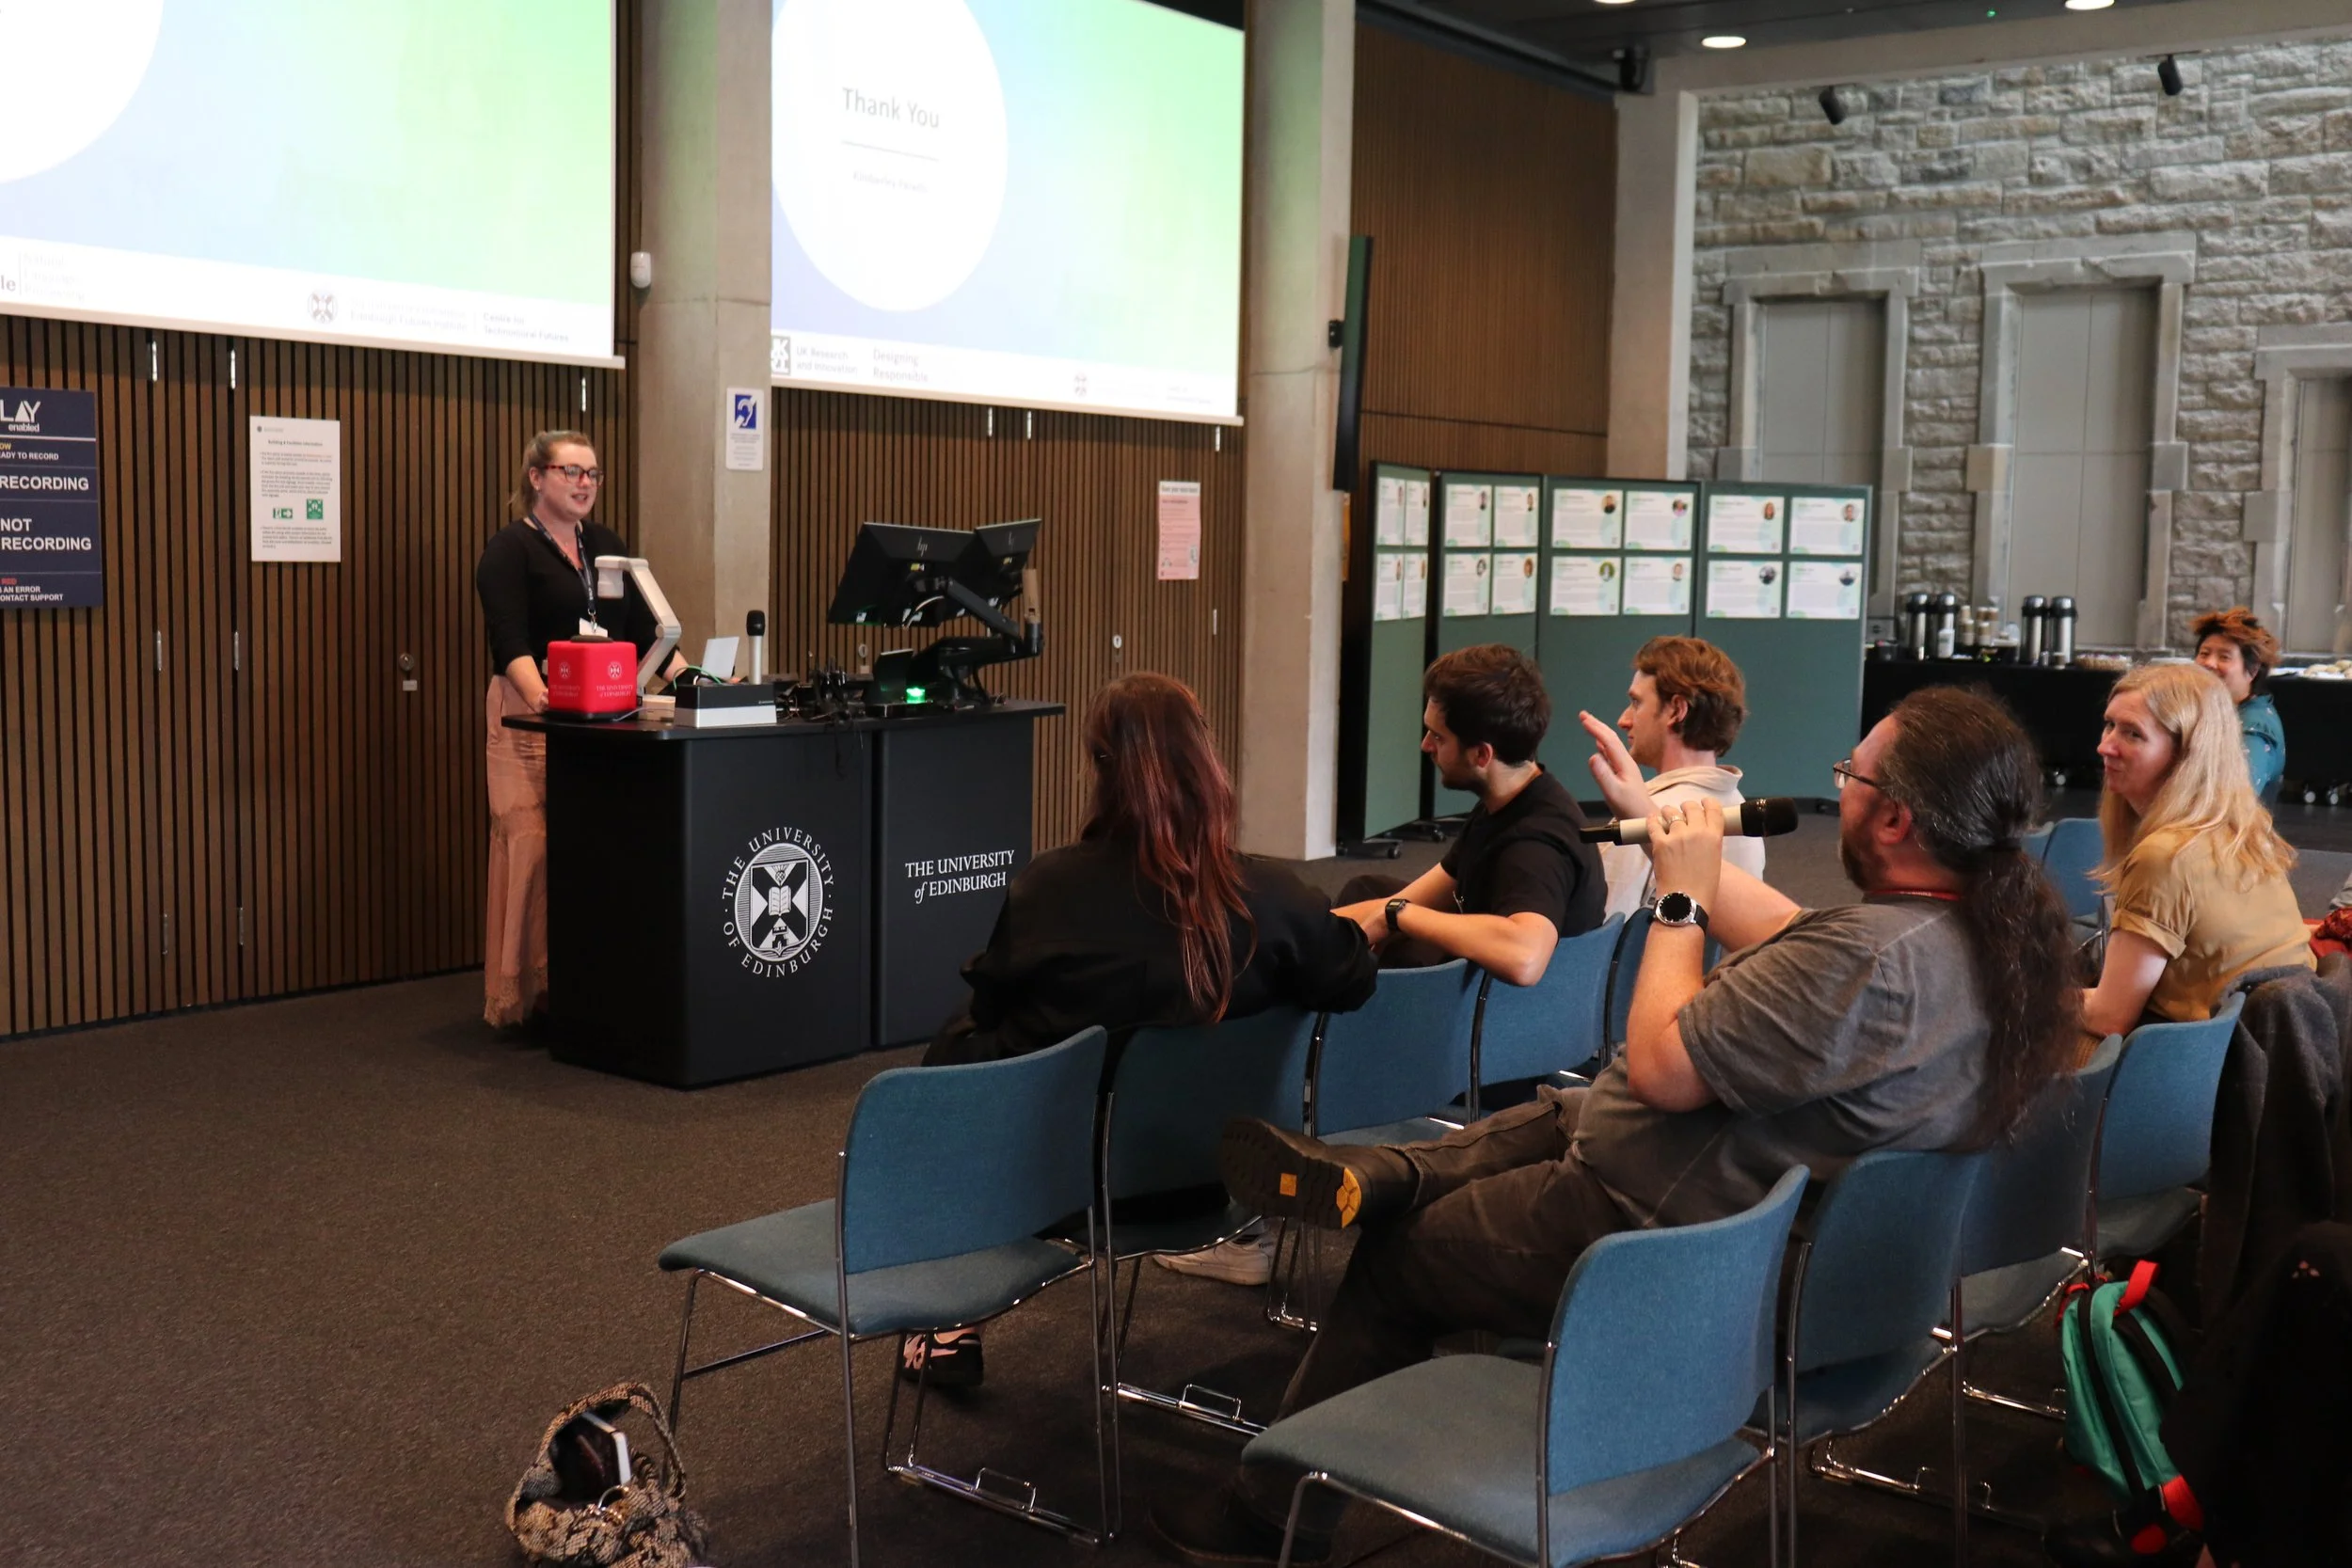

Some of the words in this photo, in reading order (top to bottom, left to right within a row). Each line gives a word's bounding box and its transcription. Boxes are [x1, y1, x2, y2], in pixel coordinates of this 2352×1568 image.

[842, 86, 900, 121] Thank
[907, 99, 939, 129] You
[796, 346, 808, 356] UK
[810, 346, 849, 360] Research
[873, 345, 919, 368] Designing
[873, 365, 929, 383] Responsible
[8, 423, 40, 433] enabled
[0, 475, 89, 490] RECORDING
[0, 518, 32, 531] NOT
[1, 537, 92, 551] RECORDING
[917, 534, 929, 557] hp
[748, 826, 834, 886] UNIVERSITY
[905, 860, 934, 878] THE
[938, 849, 1015, 874] UNIVERSITY
[722, 856, 746, 900] THE
[914, 881, 928, 905] of
[929, 871, 1007, 896] EDINBURGH
[723, 921, 740, 948] OF
[741, 908, 834, 978] EDINBURGH
